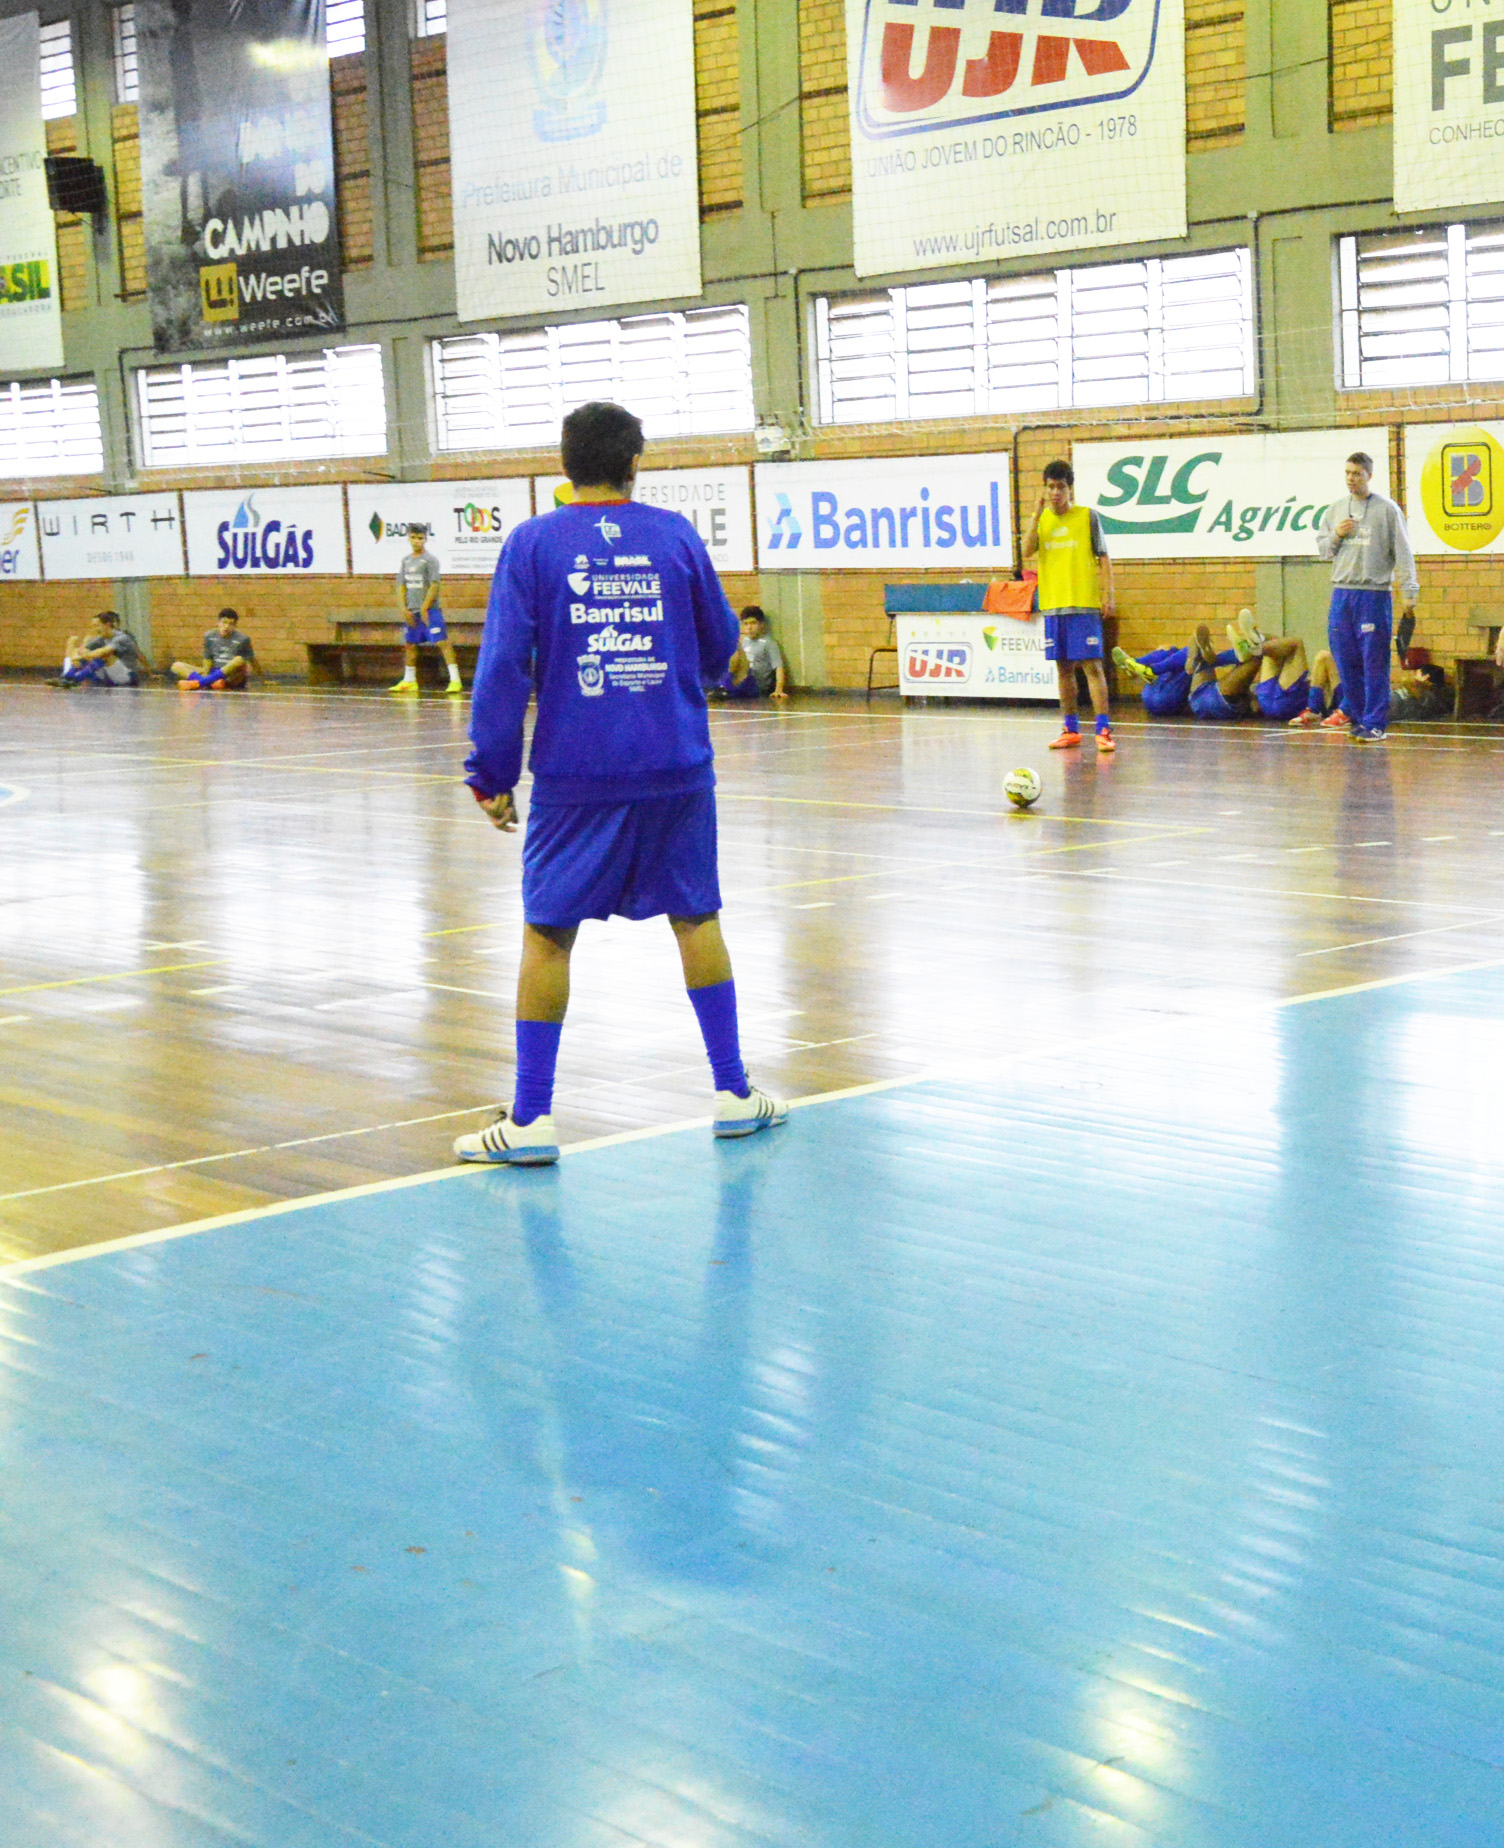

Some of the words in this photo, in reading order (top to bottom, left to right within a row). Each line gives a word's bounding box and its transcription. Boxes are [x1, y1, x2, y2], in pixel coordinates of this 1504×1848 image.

[866, 147, 916, 178] UNIÃO
[921, 141, 979, 169] JOVEM
[983, 135, 1008, 159] DO
[1012, 121, 1081, 154] RINCÃO
[1098, 114, 1138, 141] 1978
[462, 174, 552, 209] Prefeitura
[558, 152, 651, 194] Municipal
[657, 151, 683, 179] de
[204, 200, 330, 260] CAMPINHO
[487, 230, 541, 265] Novo
[547, 216, 659, 256] Hamburgo
[912, 208, 1118, 257] www.ujrfutsal.com.br
[238, 265, 329, 303] Weefe
[546, 262, 606, 297] SMEL
[1096, 451, 1223, 507] SLC
[43, 508, 176, 537] WIRTH
[810, 480, 1002, 550] Banrisul
[591, 573, 661, 581] UNIVERSIDADE
[592, 580, 662, 595] FEEVALE
[569, 599, 665, 625] Banrisul
[1001, 637, 1046, 652] FEEVAL
[908, 649, 966, 679] UJR
[998, 666, 1054, 685] Banrisul
